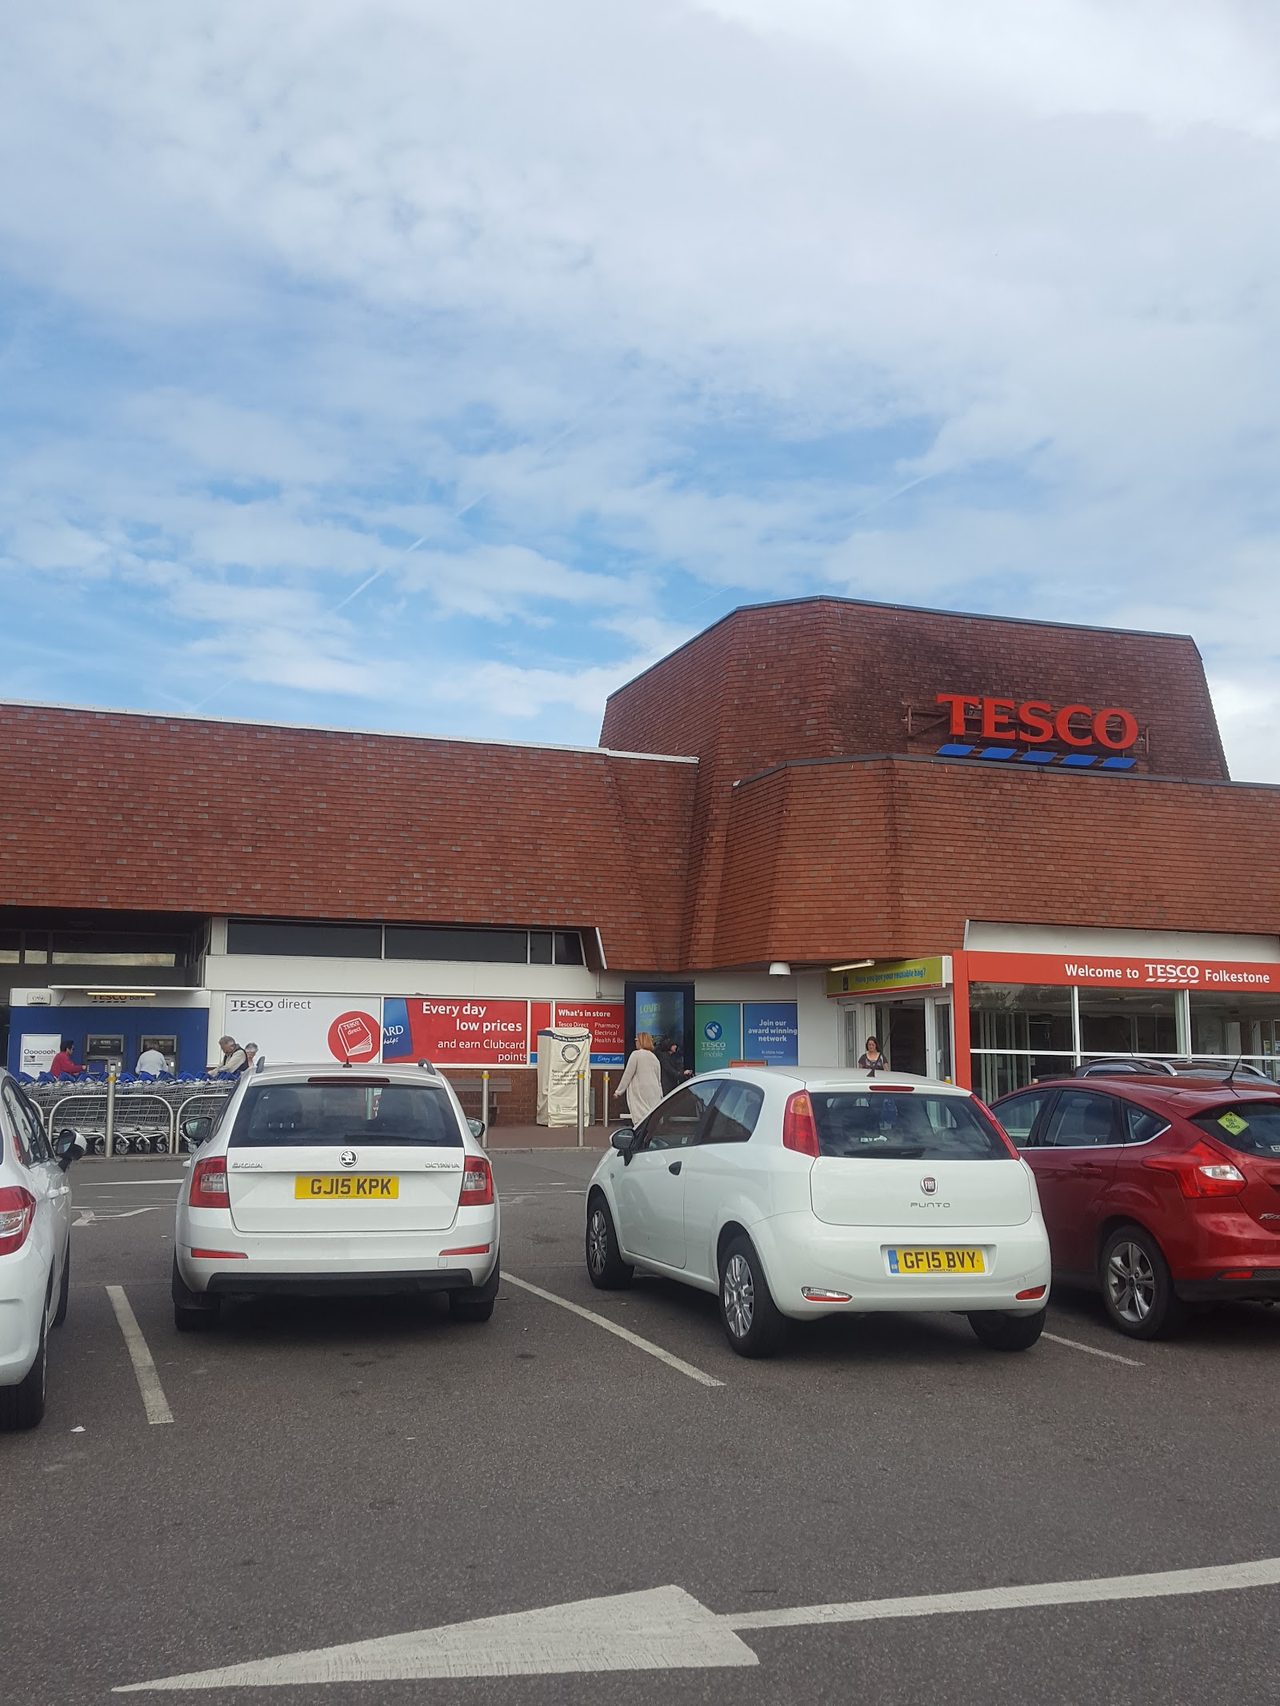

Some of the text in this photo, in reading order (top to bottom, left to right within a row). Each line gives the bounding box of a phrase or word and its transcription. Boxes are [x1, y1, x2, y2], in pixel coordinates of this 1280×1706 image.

[936, 693, 1138, 750] TESCO
[1065, 963, 1270, 984] Welcome to TESCO Folkestone
[231, 998, 311, 1010] TESCO direct
[422, 1001, 487, 1018] Every day
[558, 1009, 611, 1018] What's in store
[456, 1019, 522, 1034] low prices
[759, 1019, 773, 1027] Join
[770, 1028, 797, 1037] winning
[437, 1038, 525, 1050] and earn Clubcard
[310, 1178, 391, 1195] GJ15 KPK
[903, 1251, 976, 1269] GF15 BVY
